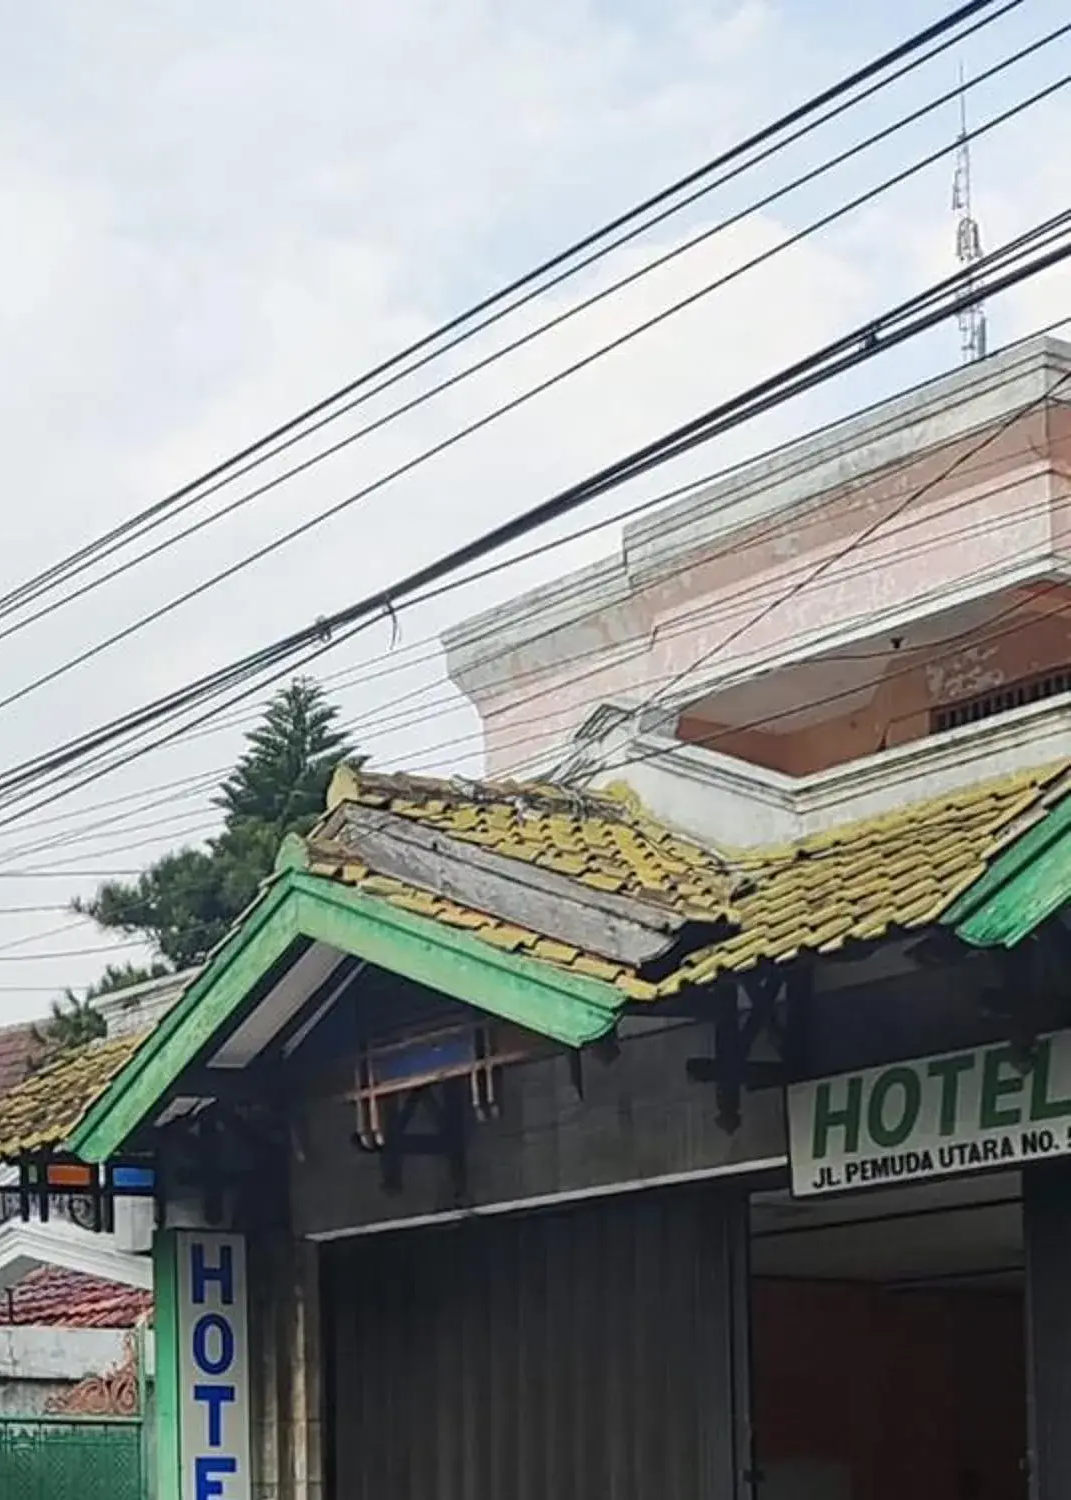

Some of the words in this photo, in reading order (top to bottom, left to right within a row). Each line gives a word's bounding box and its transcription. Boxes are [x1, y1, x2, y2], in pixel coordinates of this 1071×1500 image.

[813, 1038, 1071, 1160] HOTEL
[813, 1166, 840, 1189] JL.
[844, 1149, 934, 1184] PEMUDA
[939, 1136, 1014, 1168] UTARA
[1020, 1130, 1060, 1155] NO.
